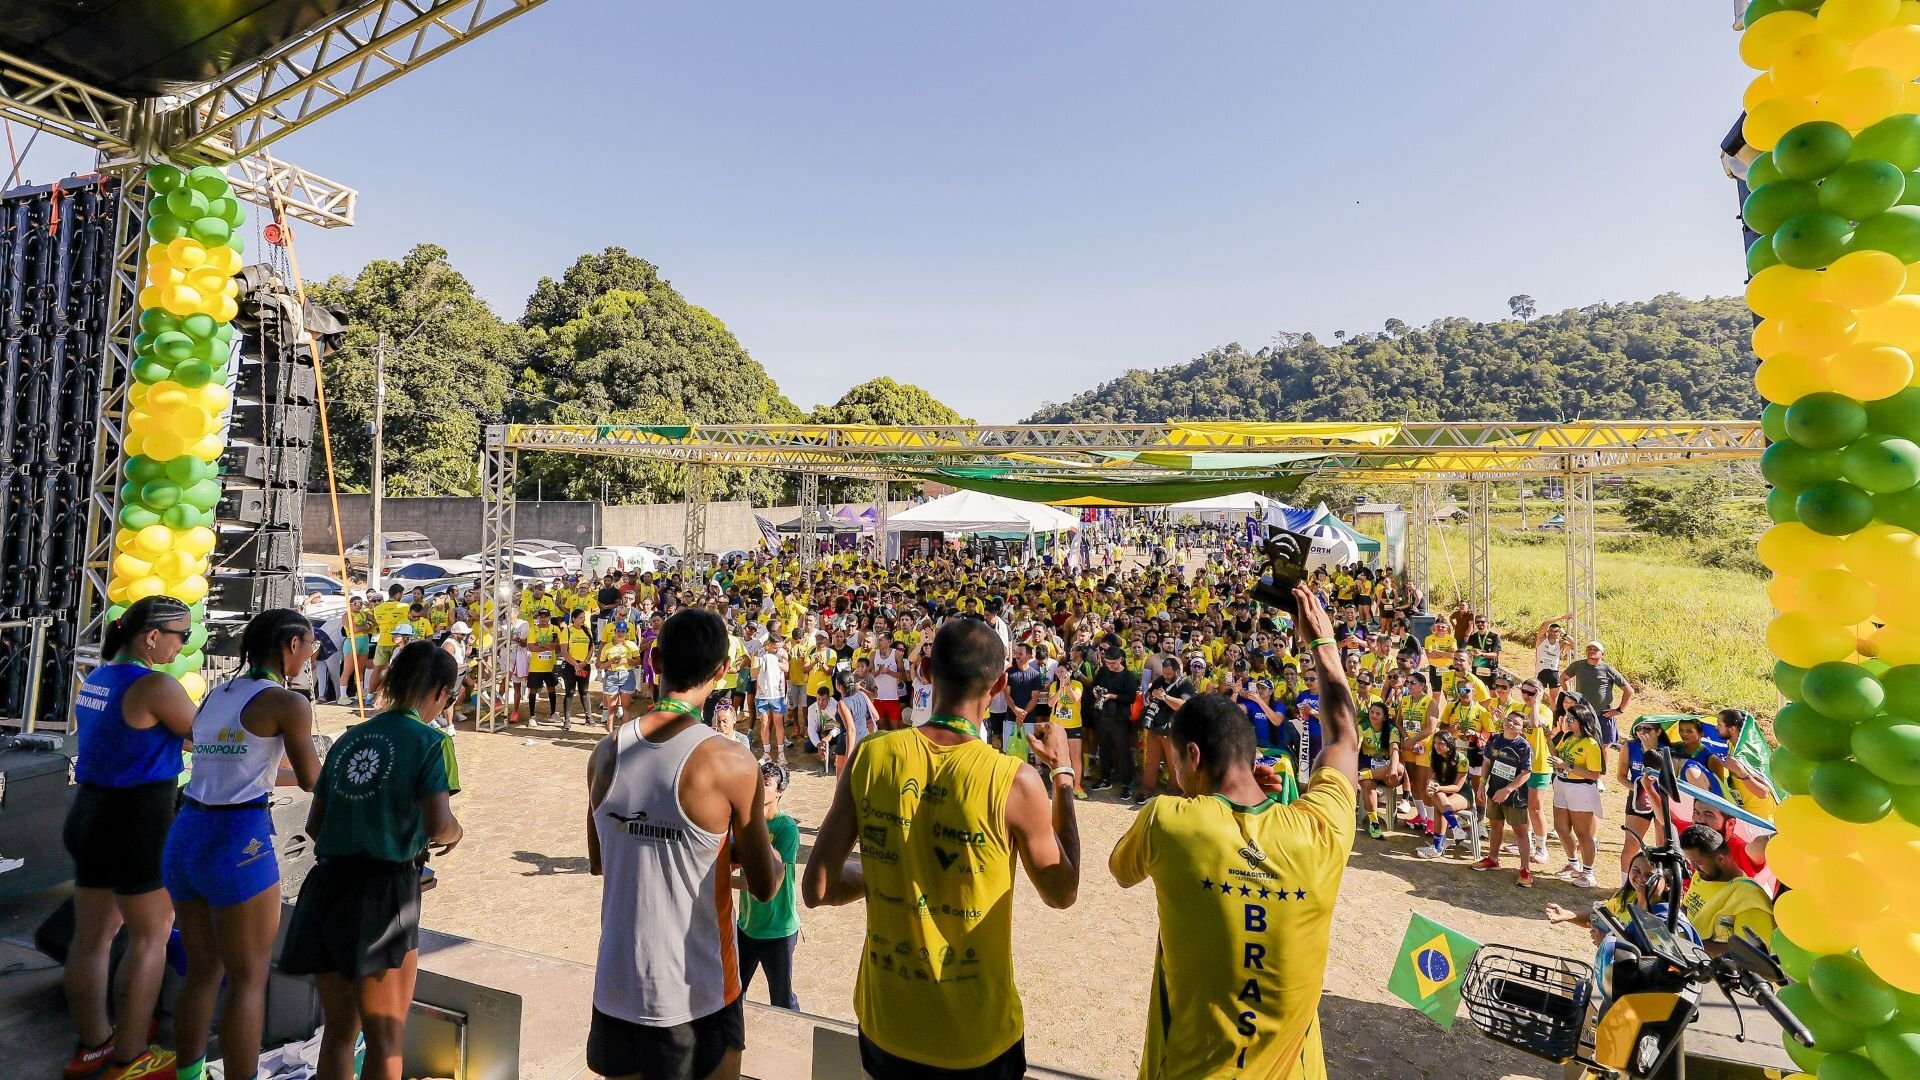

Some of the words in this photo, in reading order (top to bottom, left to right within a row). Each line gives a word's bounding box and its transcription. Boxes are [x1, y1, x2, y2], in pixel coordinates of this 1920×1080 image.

[1310, 546, 1331, 555] ORTH
[628, 822, 683, 841] ROADRUNNER
[958, 864, 986, 875] VALE
[1228, 868, 1280, 880] BIOMAGISTRAL
[1232, 903, 1268, 1080] BRASI
